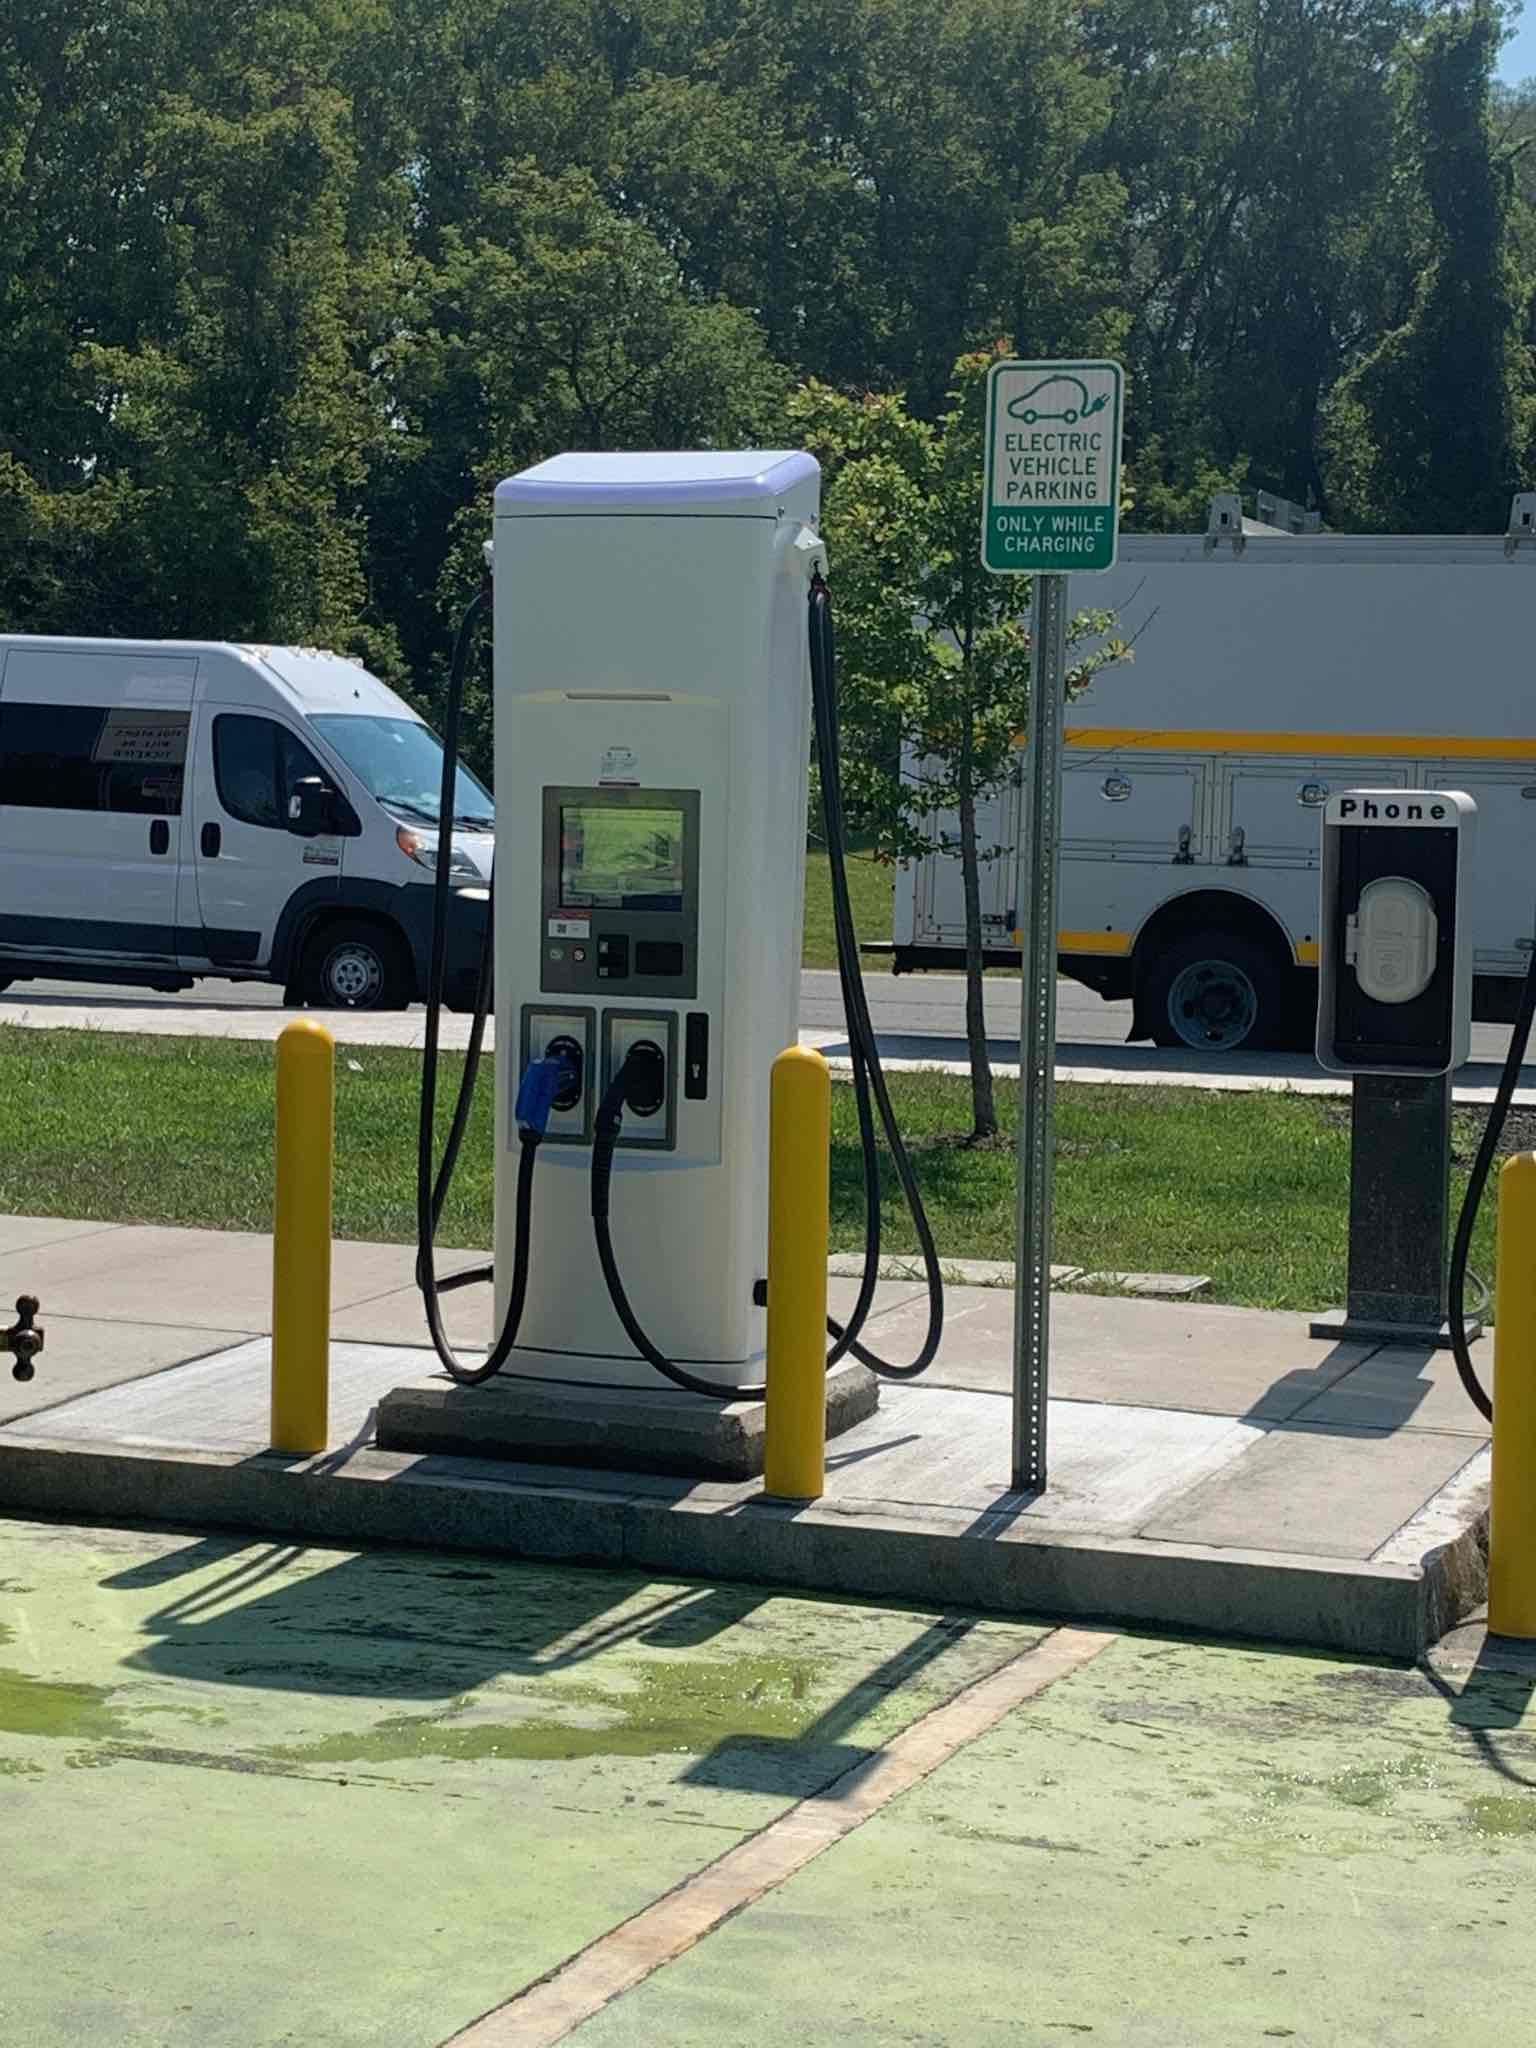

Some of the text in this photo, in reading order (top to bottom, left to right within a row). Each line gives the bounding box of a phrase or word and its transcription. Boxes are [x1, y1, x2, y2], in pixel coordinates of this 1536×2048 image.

[1005, 433, 1101, 452] ELECTRIC
[1010, 457, 1097, 475] VEHICLE
[1007, 481, 1097, 499] PARKING
[997, 516, 1104, 532] ONLY WHILE
[1004, 536, 1095, 552] CHARGING
[1340, 799, 1446, 819] Phone
